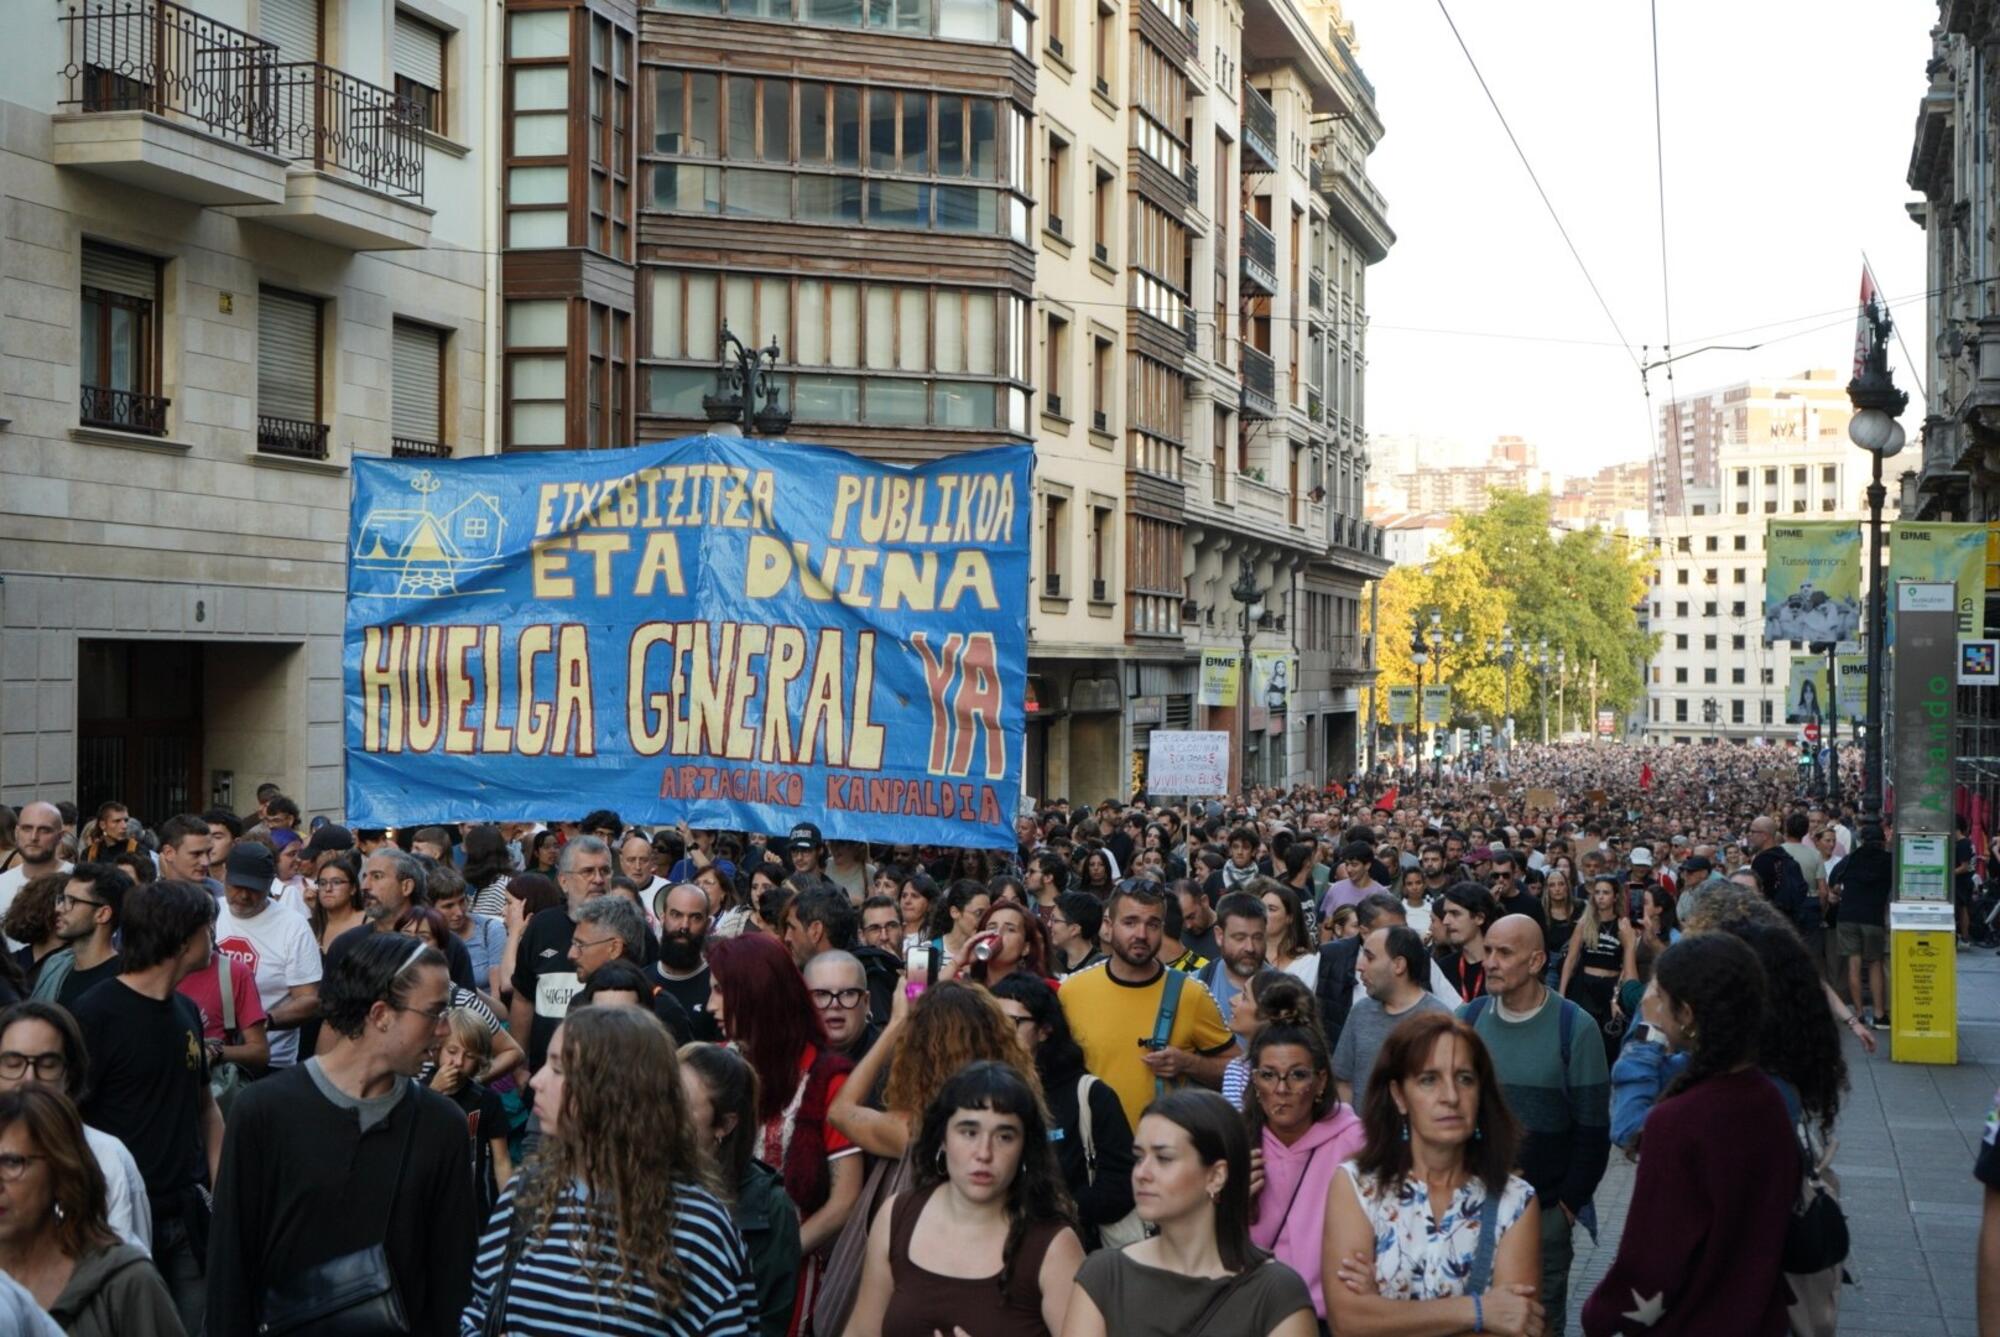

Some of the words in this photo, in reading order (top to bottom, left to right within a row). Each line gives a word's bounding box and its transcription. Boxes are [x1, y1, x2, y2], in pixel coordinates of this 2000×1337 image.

[1770, 422, 1797, 438] NYX
[534, 464, 776, 536] ETXEBIZITZA
[830, 472, 1015, 544] PUBLIKOA
[531, 530, 687, 599] ETA
[744, 534, 1002, 611] DUINA
[195, 600, 206, 623] 8
[361, 622, 596, 757] HUELGA
[627, 620, 885, 772] GENERAL
[910, 632, 1006, 780] YA
[1919, 675, 1950, 813] Abando
[826, 774, 1000, 826] KANPALDIA
